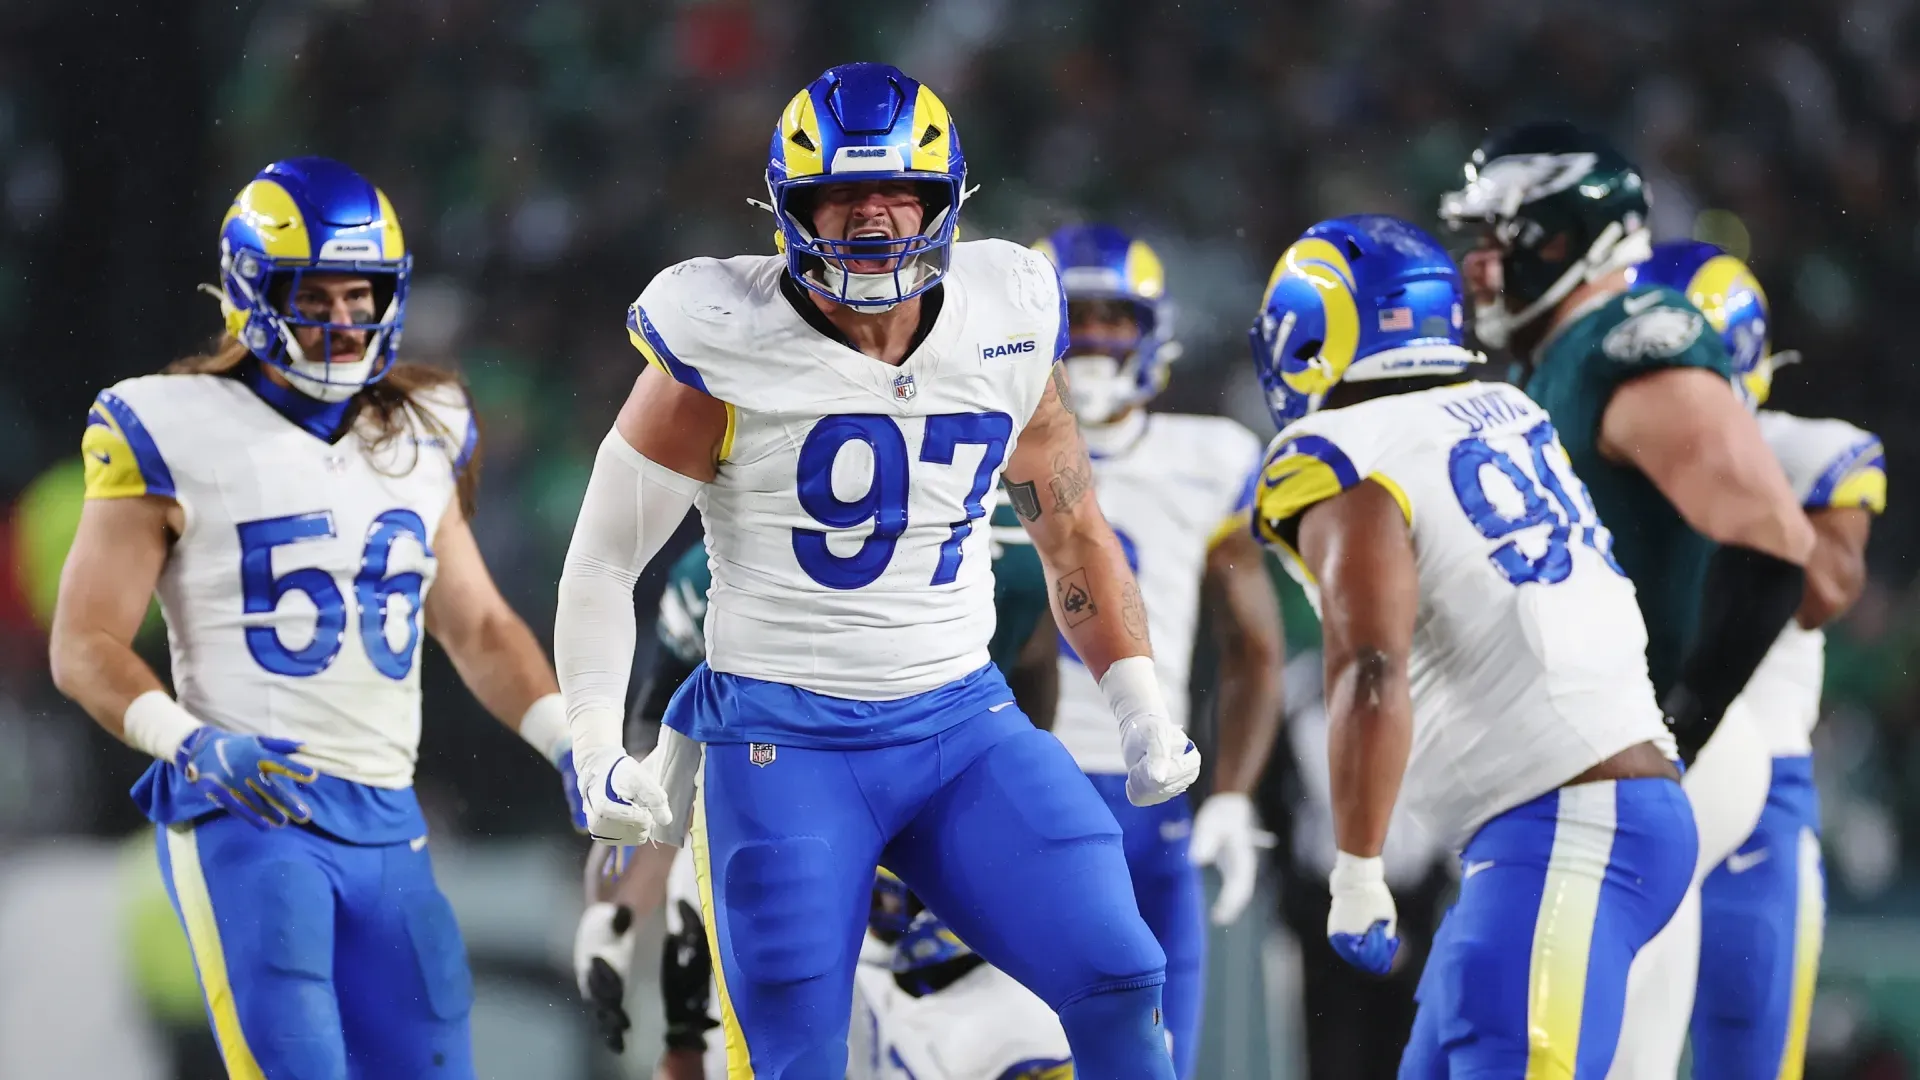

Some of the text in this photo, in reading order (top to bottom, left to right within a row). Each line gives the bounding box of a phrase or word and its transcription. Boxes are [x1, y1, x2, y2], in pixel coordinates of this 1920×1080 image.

[847, 149, 886, 158] RAMS
[982, 340, 1036, 360] RAMS
[791, 411, 1014, 591] 97
[234, 508, 435, 681] 56
[753, 750, 771, 762] NFL
